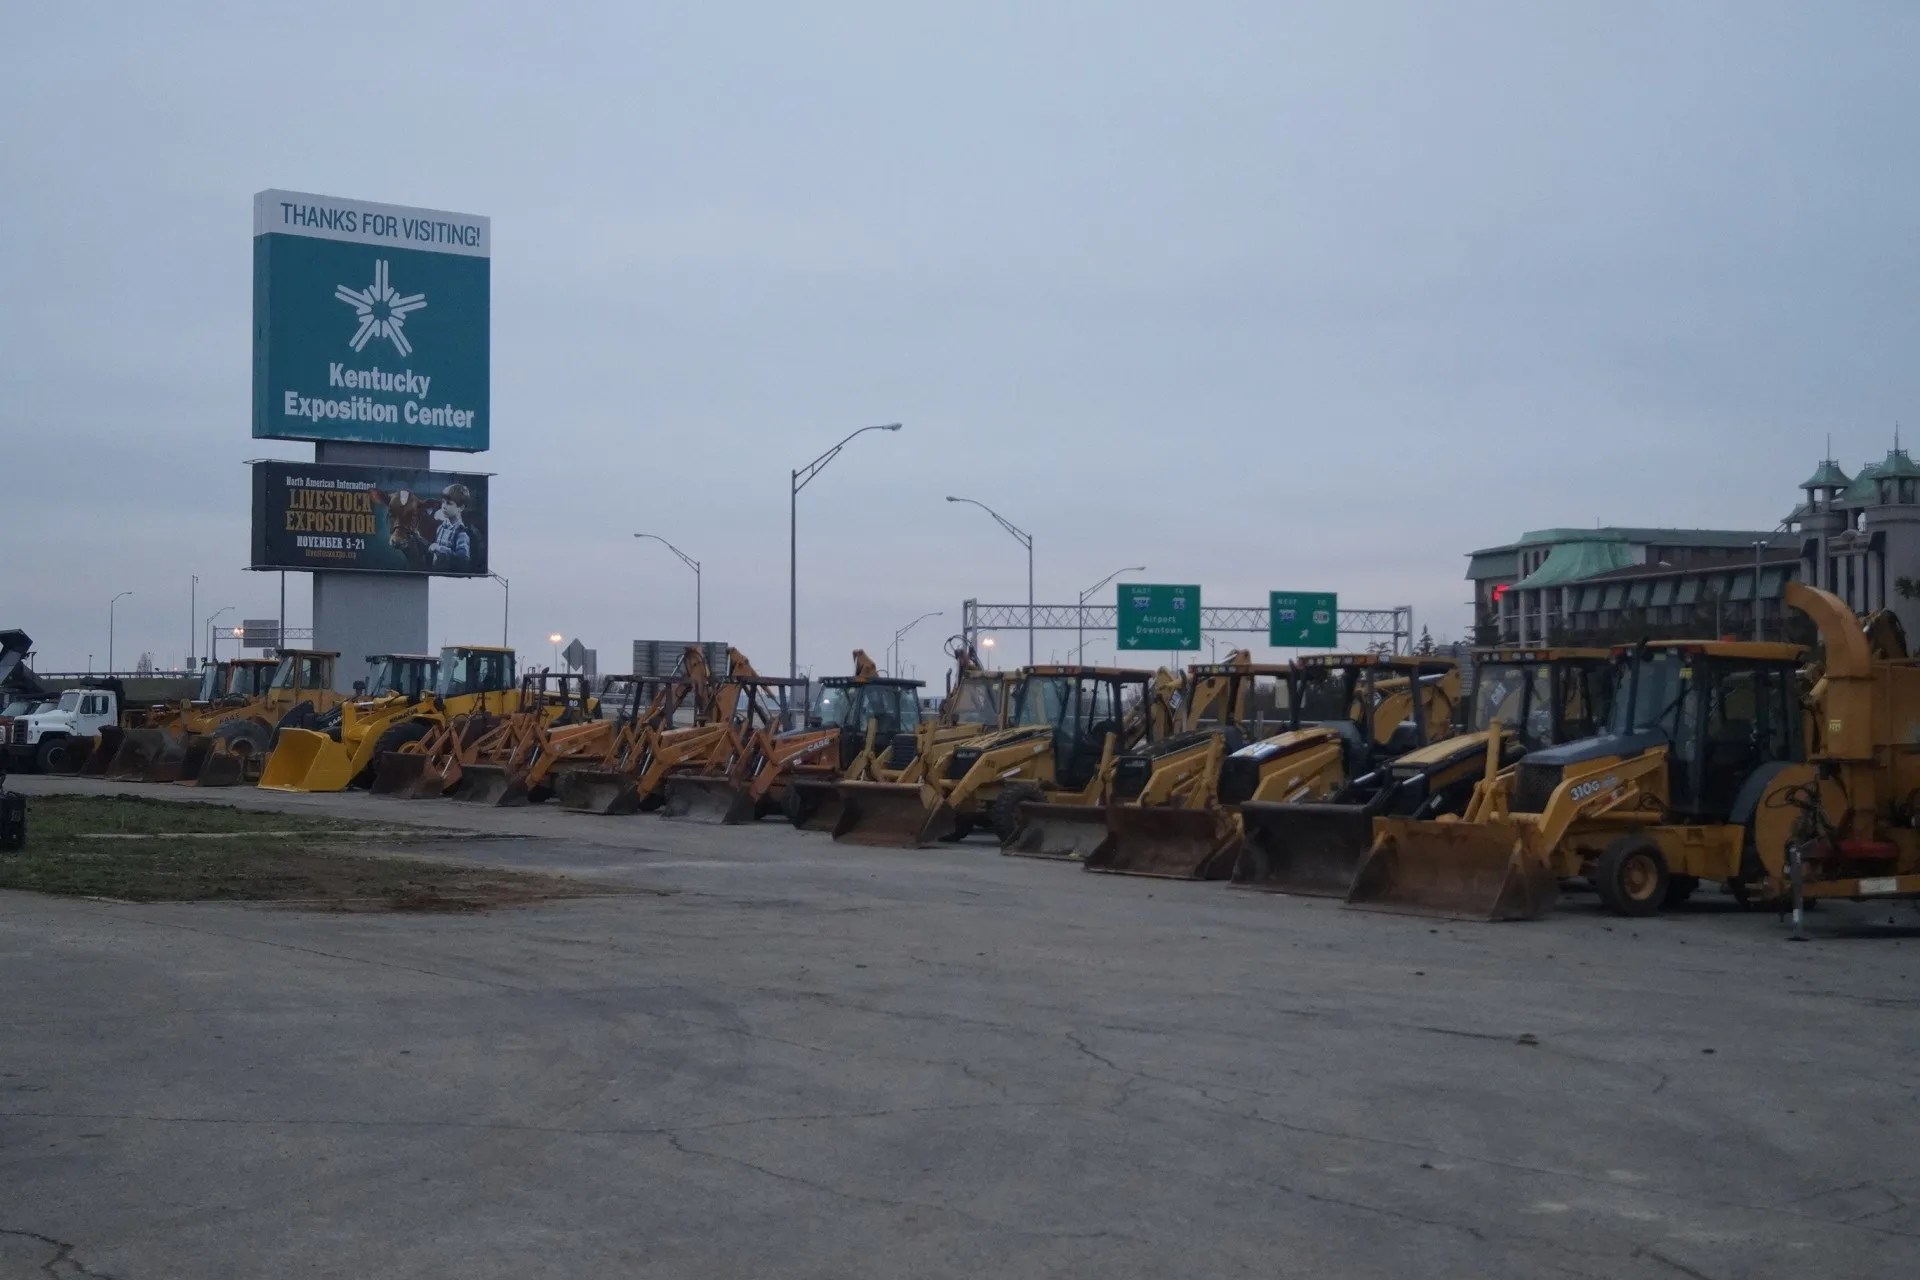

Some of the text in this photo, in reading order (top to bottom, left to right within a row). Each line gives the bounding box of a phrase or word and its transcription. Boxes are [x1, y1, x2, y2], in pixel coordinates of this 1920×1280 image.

[280, 202, 481, 247] THANKS FOR VISITING!
[329, 362, 431, 399] Kentucky
[284, 390, 475, 428] Exposition Center
[286, 476, 304, 487] North
[305, 477, 335, 488] American
[289, 489, 373, 513] LIVESTOCK
[285, 510, 376, 535] EXPOSITION
[296, 535, 365, 550] NOVEMBER 5-21
[1136, 626, 1183, 634] Downtown
[1142, 614, 1177, 626] Airport
[807, 736, 830, 751] CASE
[1569, 780, 1600, 801] 310G
